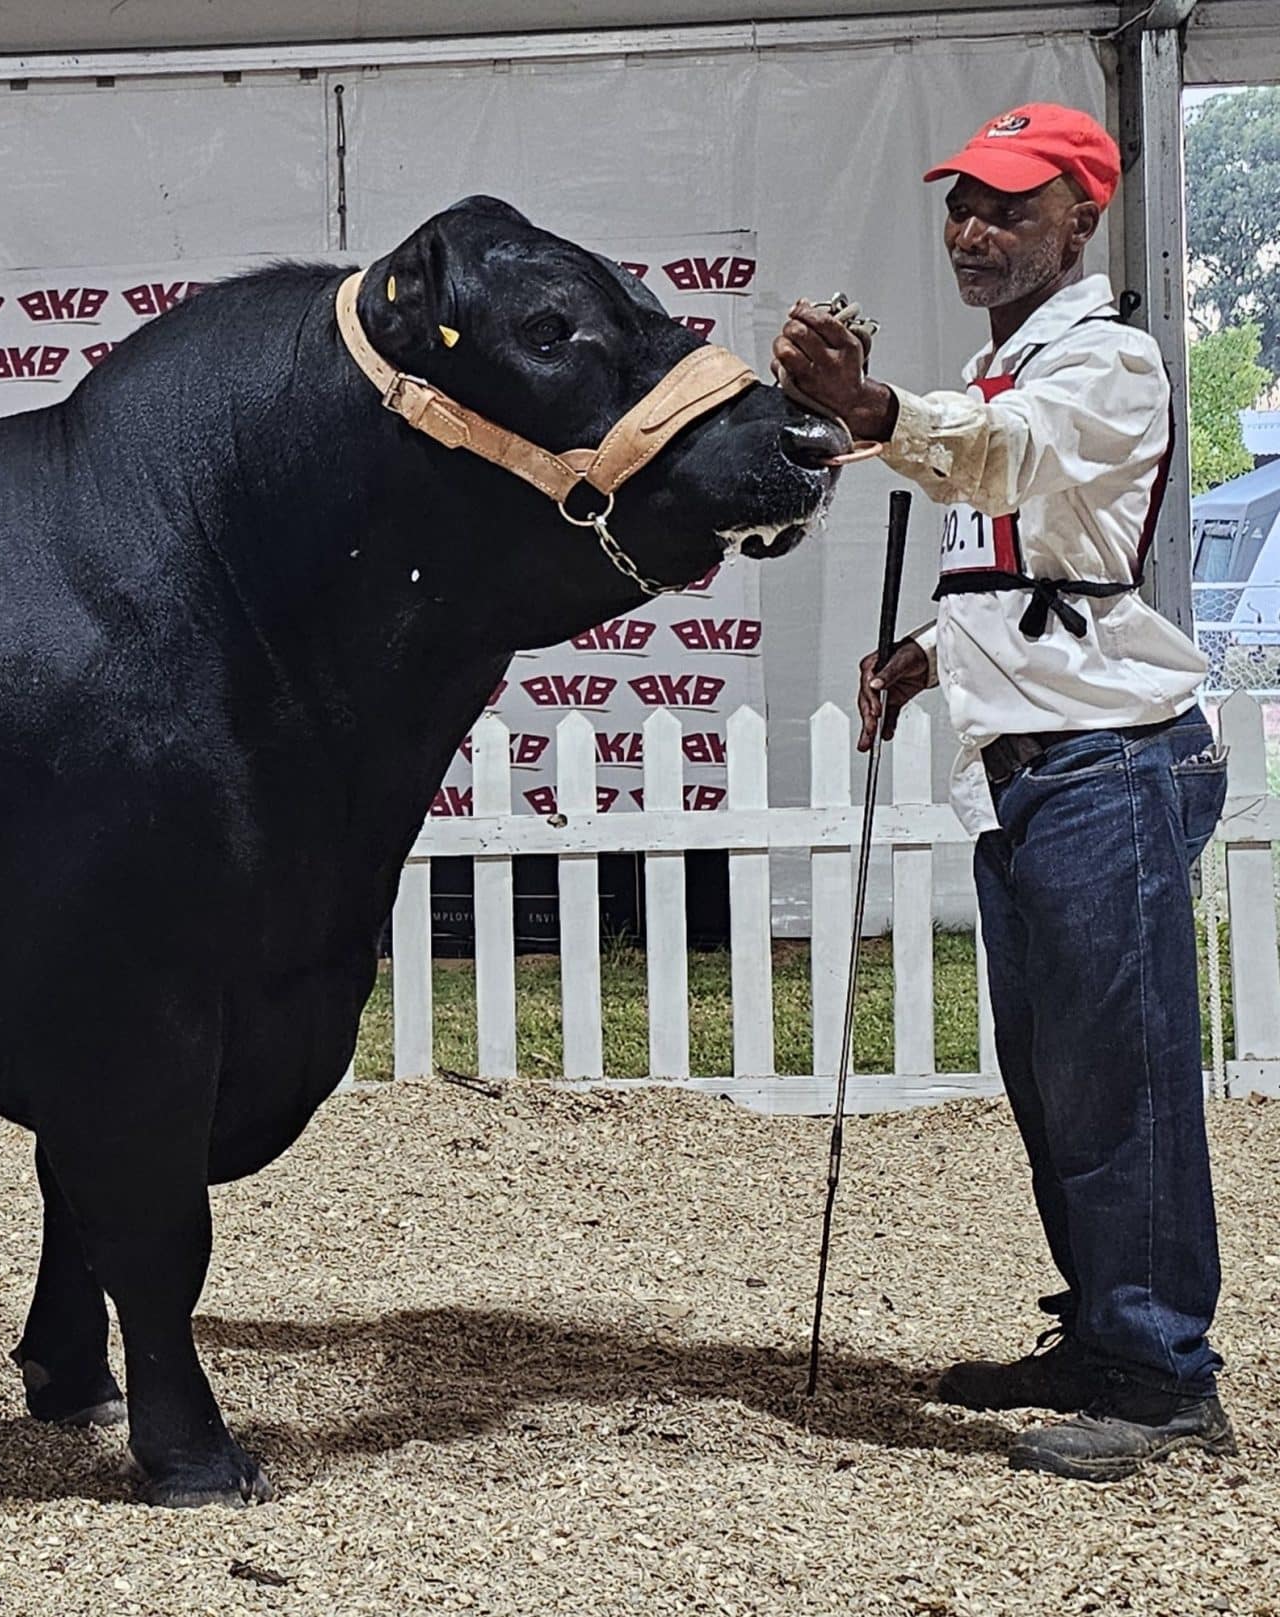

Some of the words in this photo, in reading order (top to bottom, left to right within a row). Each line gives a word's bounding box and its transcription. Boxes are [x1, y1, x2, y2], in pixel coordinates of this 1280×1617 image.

[662, 256, 756, 290] BKB
[17, 288, 109, 321] BKB
[670, 619, 762, 650] BKB
[520, 675, 617, 705] BKB
[627, 675, 725, 705] BKB
